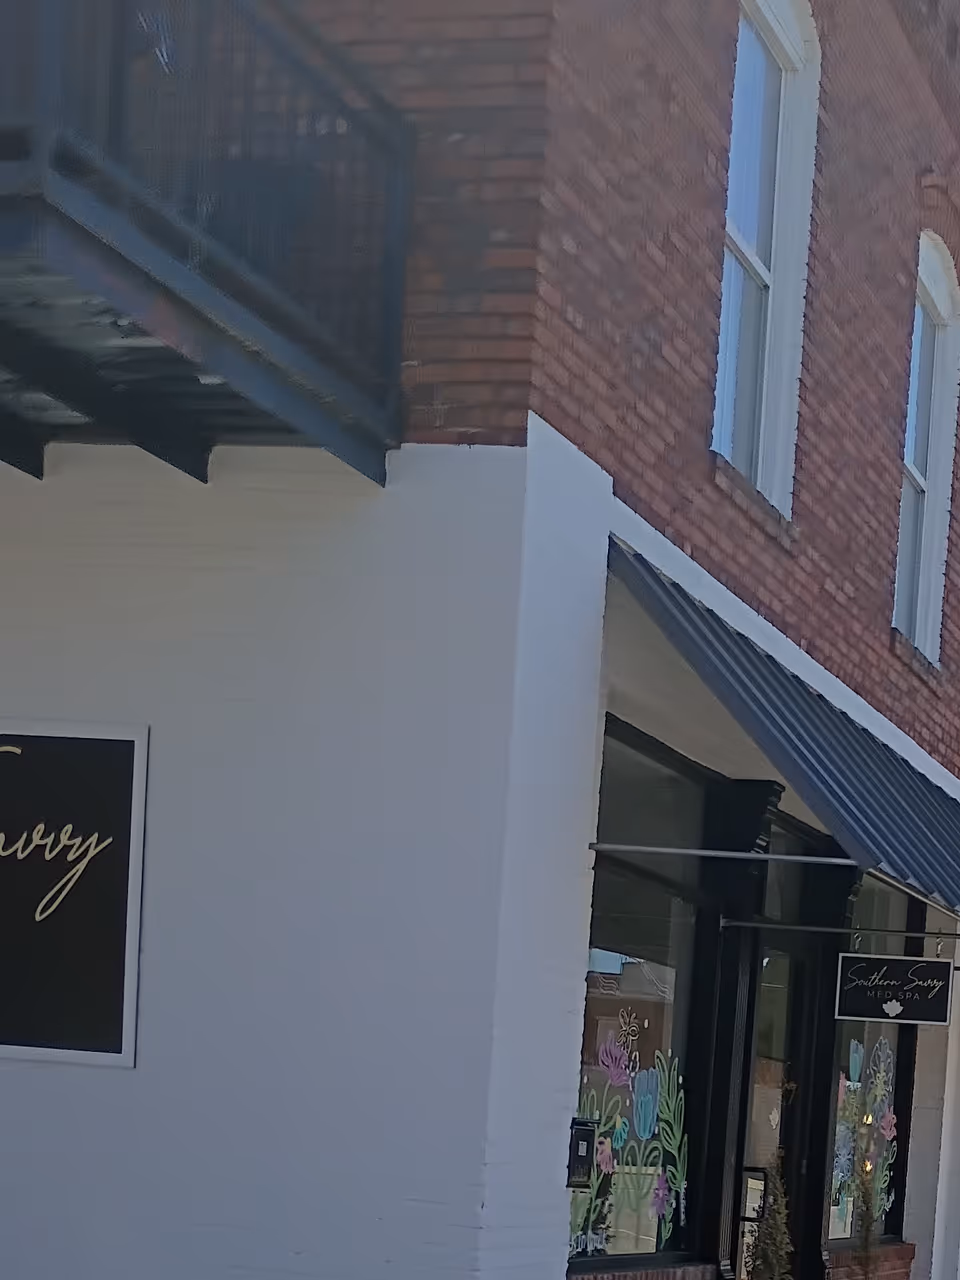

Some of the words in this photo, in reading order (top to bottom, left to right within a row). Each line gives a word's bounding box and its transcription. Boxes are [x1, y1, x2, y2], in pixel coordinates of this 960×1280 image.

[844, 963, 901, 990] Southern
[867, 990, 892, 999] MED
[898, 991, 920, 1000] SPA
